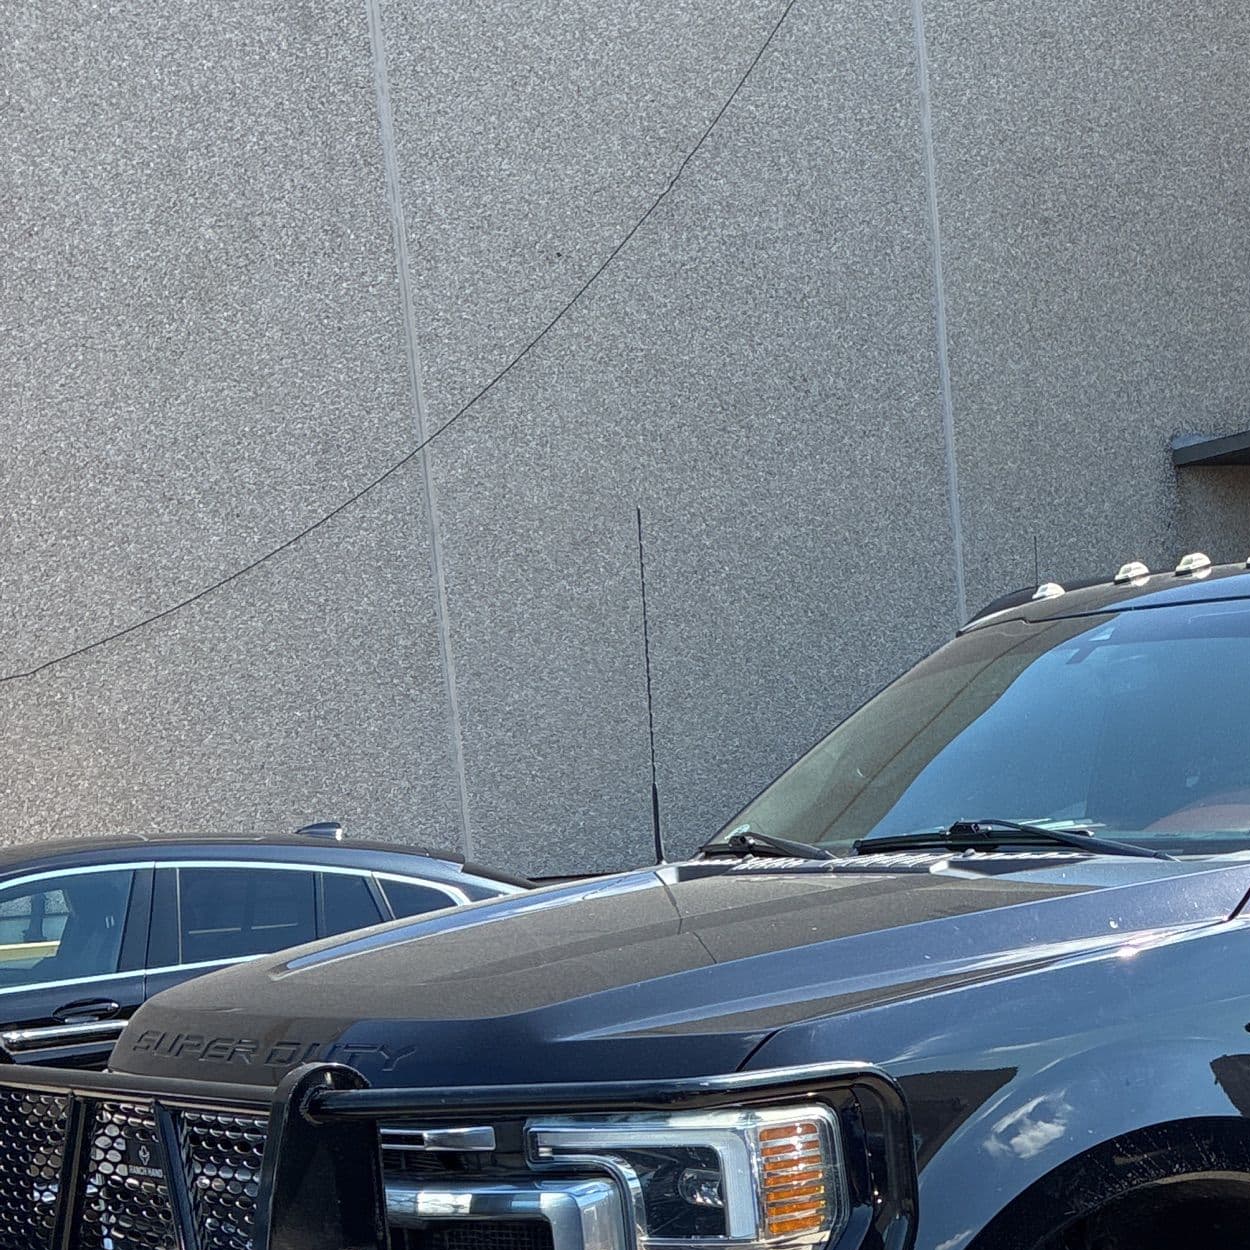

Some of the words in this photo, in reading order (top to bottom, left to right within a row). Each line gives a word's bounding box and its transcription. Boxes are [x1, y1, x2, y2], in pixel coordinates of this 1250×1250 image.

[132, 1029, 258, 1065] SUPER
[263, 1041, 417, 1072] DUTY
[128, 1164, 149, 1176] RANCH
[149, 1167, 163, 1179] HAND
